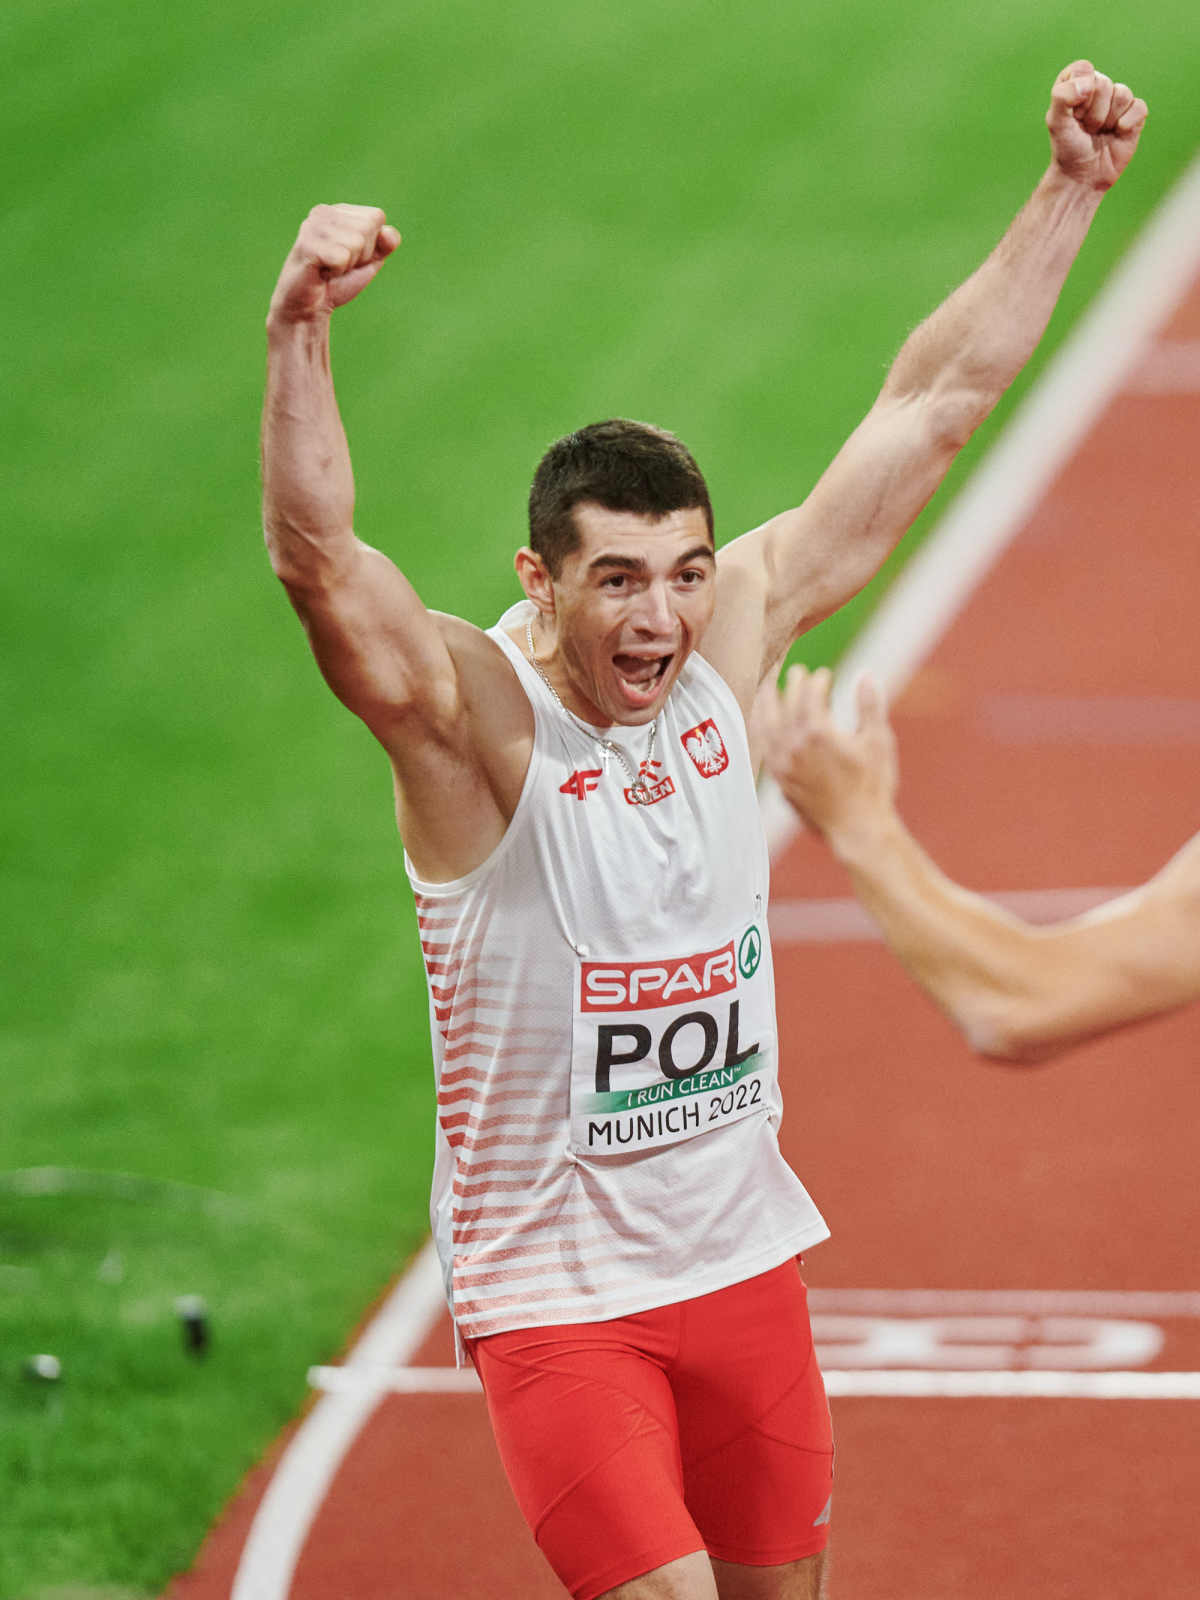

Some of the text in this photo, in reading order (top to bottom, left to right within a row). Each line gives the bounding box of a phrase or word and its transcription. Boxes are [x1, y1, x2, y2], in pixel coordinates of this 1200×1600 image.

[585, 950, 736, 1006] SPAR
[595, 999, 760, 1093] POL
[588, 1078, 762, 1147] MUNICH 2022
[626, 1092, 633, 1108] I
[636, 1081, 674, 1104] RUN
